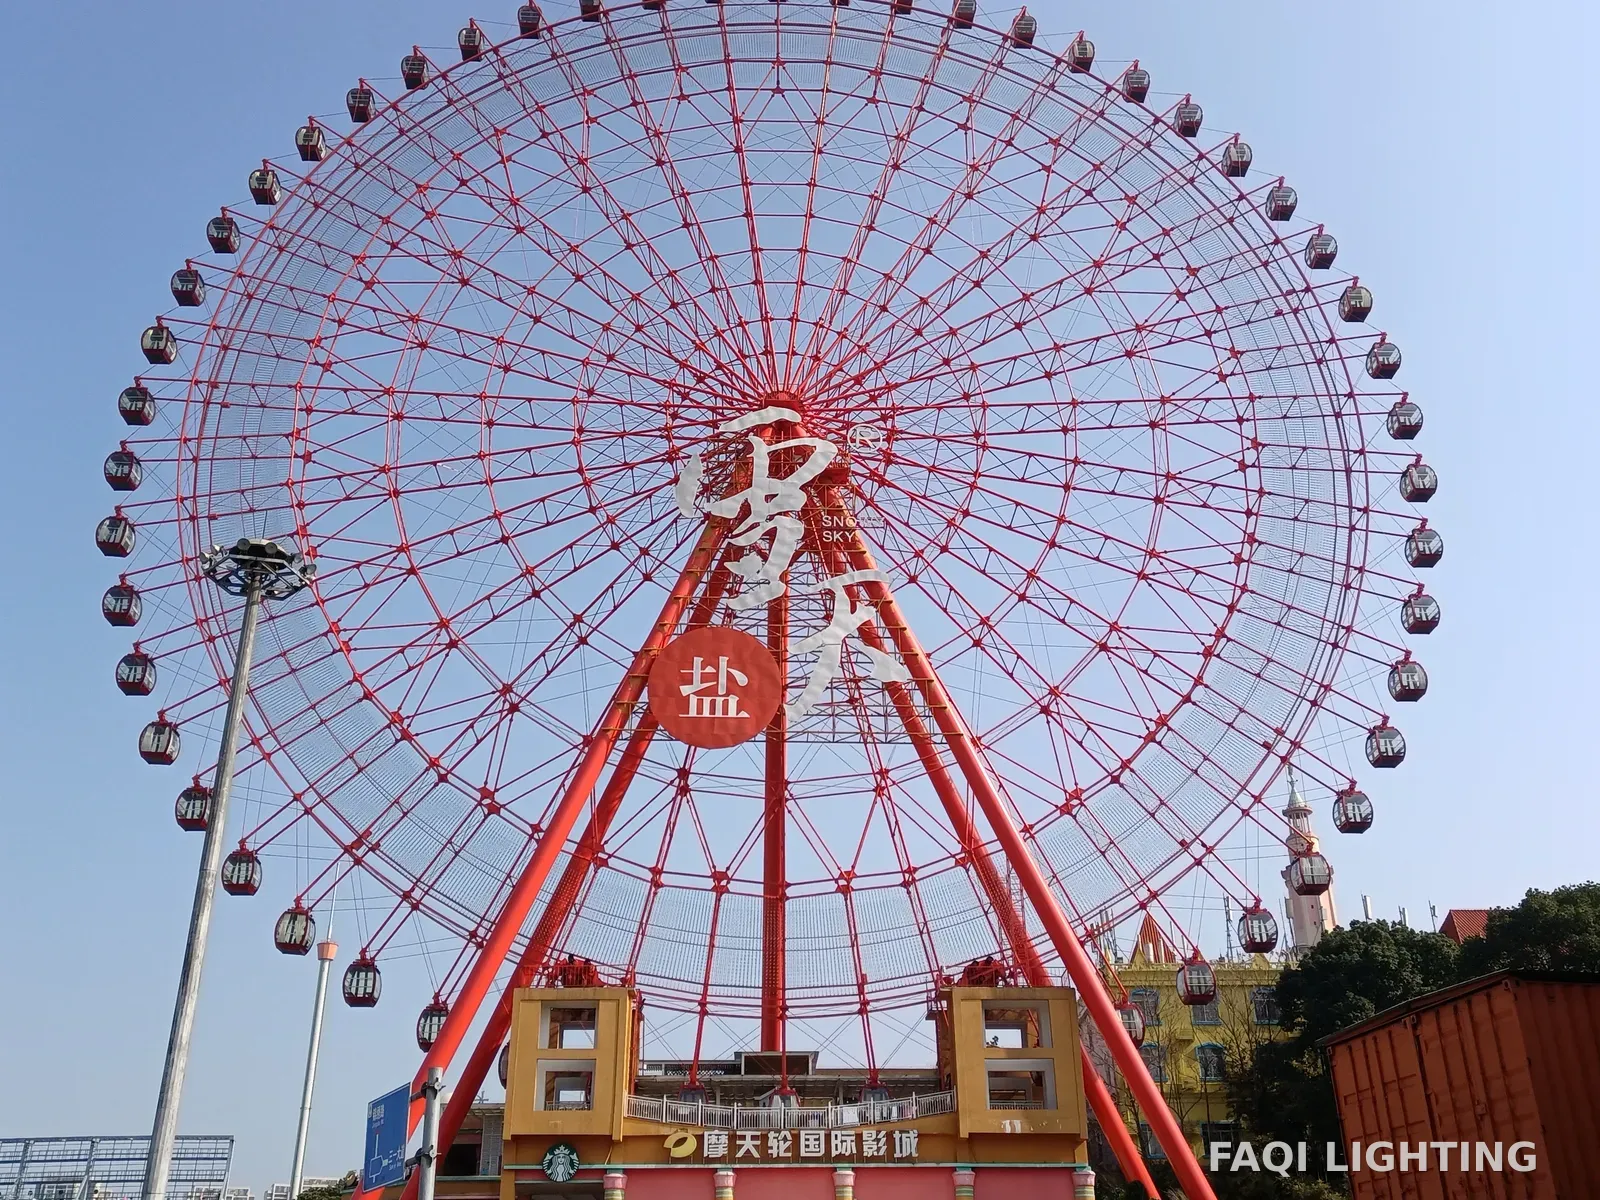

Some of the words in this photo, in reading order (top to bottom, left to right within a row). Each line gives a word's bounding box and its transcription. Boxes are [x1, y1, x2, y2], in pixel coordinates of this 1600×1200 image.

[822, 530, 855, 543] SKY
[679, 656, 750, 719] 盐
[703, 1129, 919, 1158] 摩天轮国际影城
